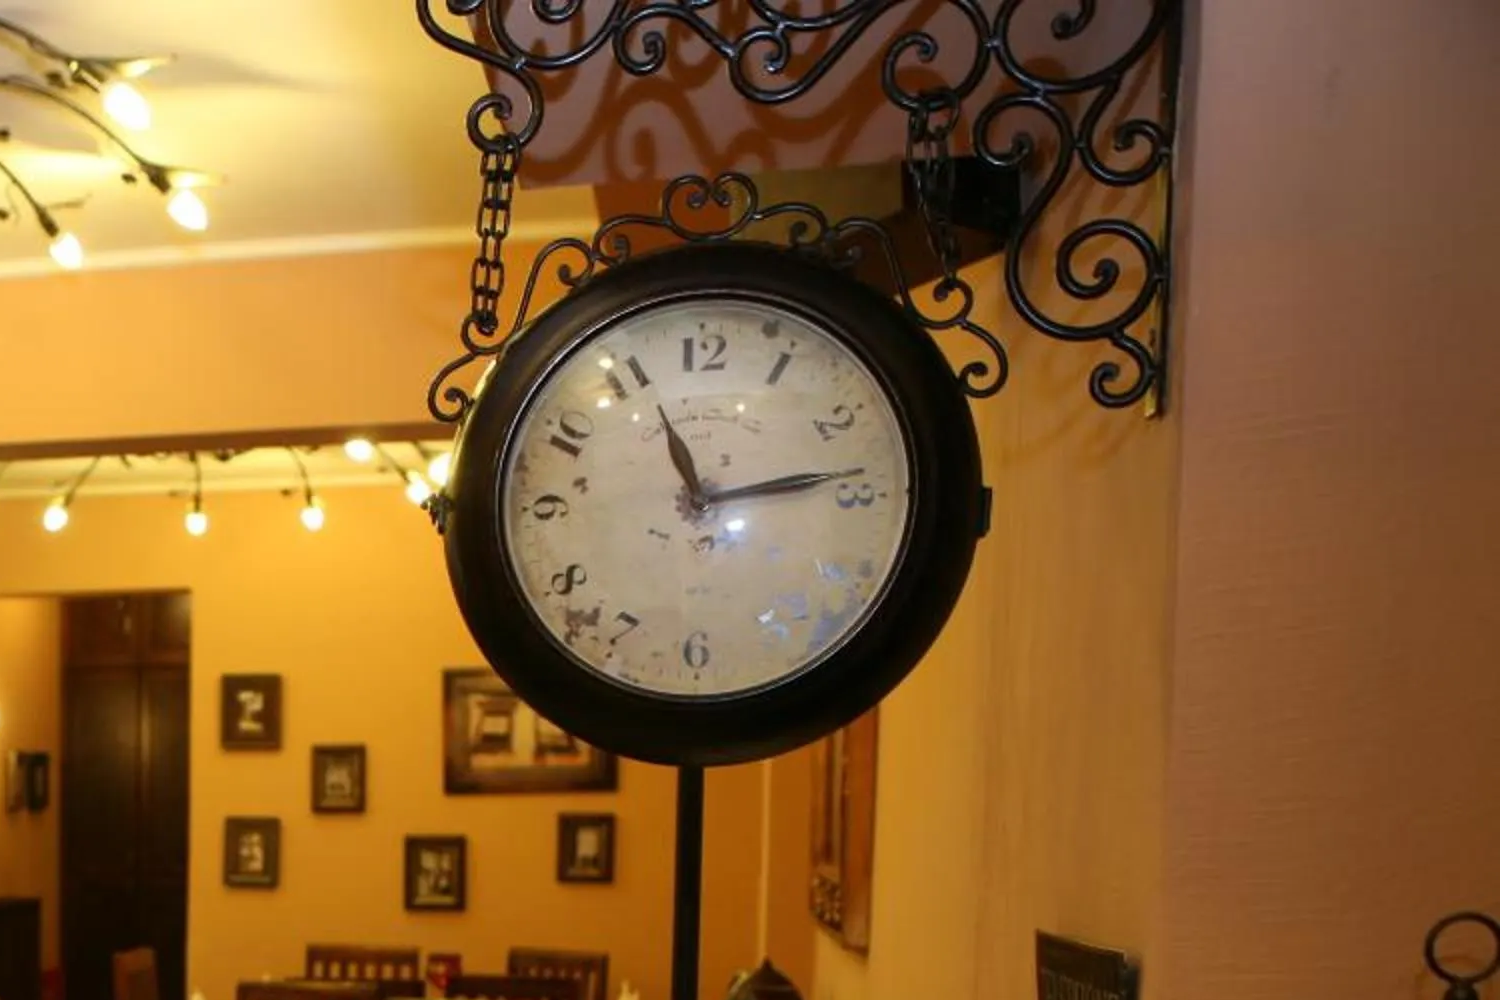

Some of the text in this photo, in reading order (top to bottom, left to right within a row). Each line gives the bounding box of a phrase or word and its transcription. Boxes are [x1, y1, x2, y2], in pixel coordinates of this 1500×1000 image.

[682, 335, 727, 372] 12
[767, 352, 792, 386] 1
[605, 354, 650, 400] 11
[550, 410, 594, 458] 10
[813, 404, 855, 442] 2
[533, 494, 569, 521] 9
[835, 483, 875, 510] 3
[551, 563, 587, 595] 8
[610, 611, 640, 645] 7
[683, 630, 710, 669] 6
